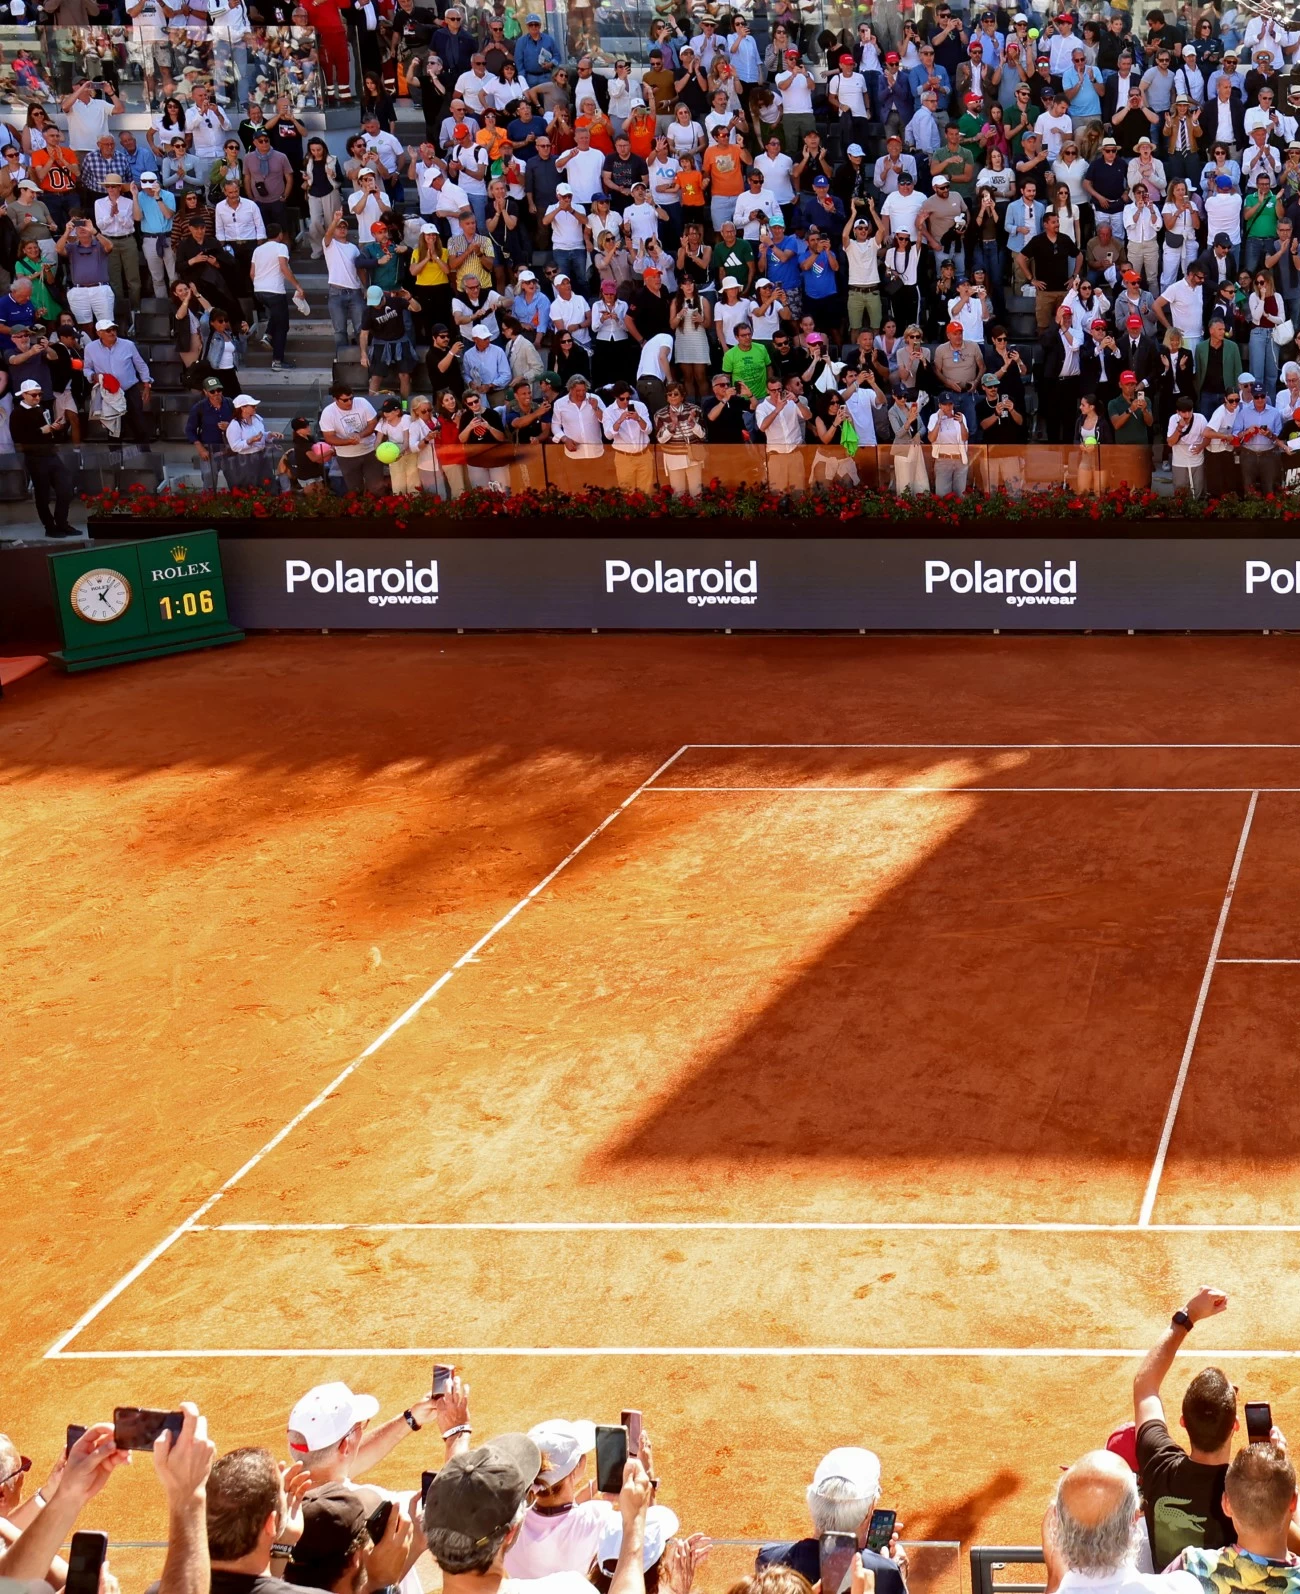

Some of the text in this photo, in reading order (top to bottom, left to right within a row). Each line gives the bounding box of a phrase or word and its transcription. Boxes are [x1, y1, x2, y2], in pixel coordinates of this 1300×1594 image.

[151, 562, 212, 582] ROLEX
[286, 560, 439, 594] Polaroid
[606, 560, 758, 594] Polaroid
[925, 560, 1077, 594] Polaroid
[160, 589, 214, 620] 1:06
[367, 595, 439, 607] eyewear
[687, 595, 758, 607] eyewear
[1006, 595, 1077, 608] eyewear
